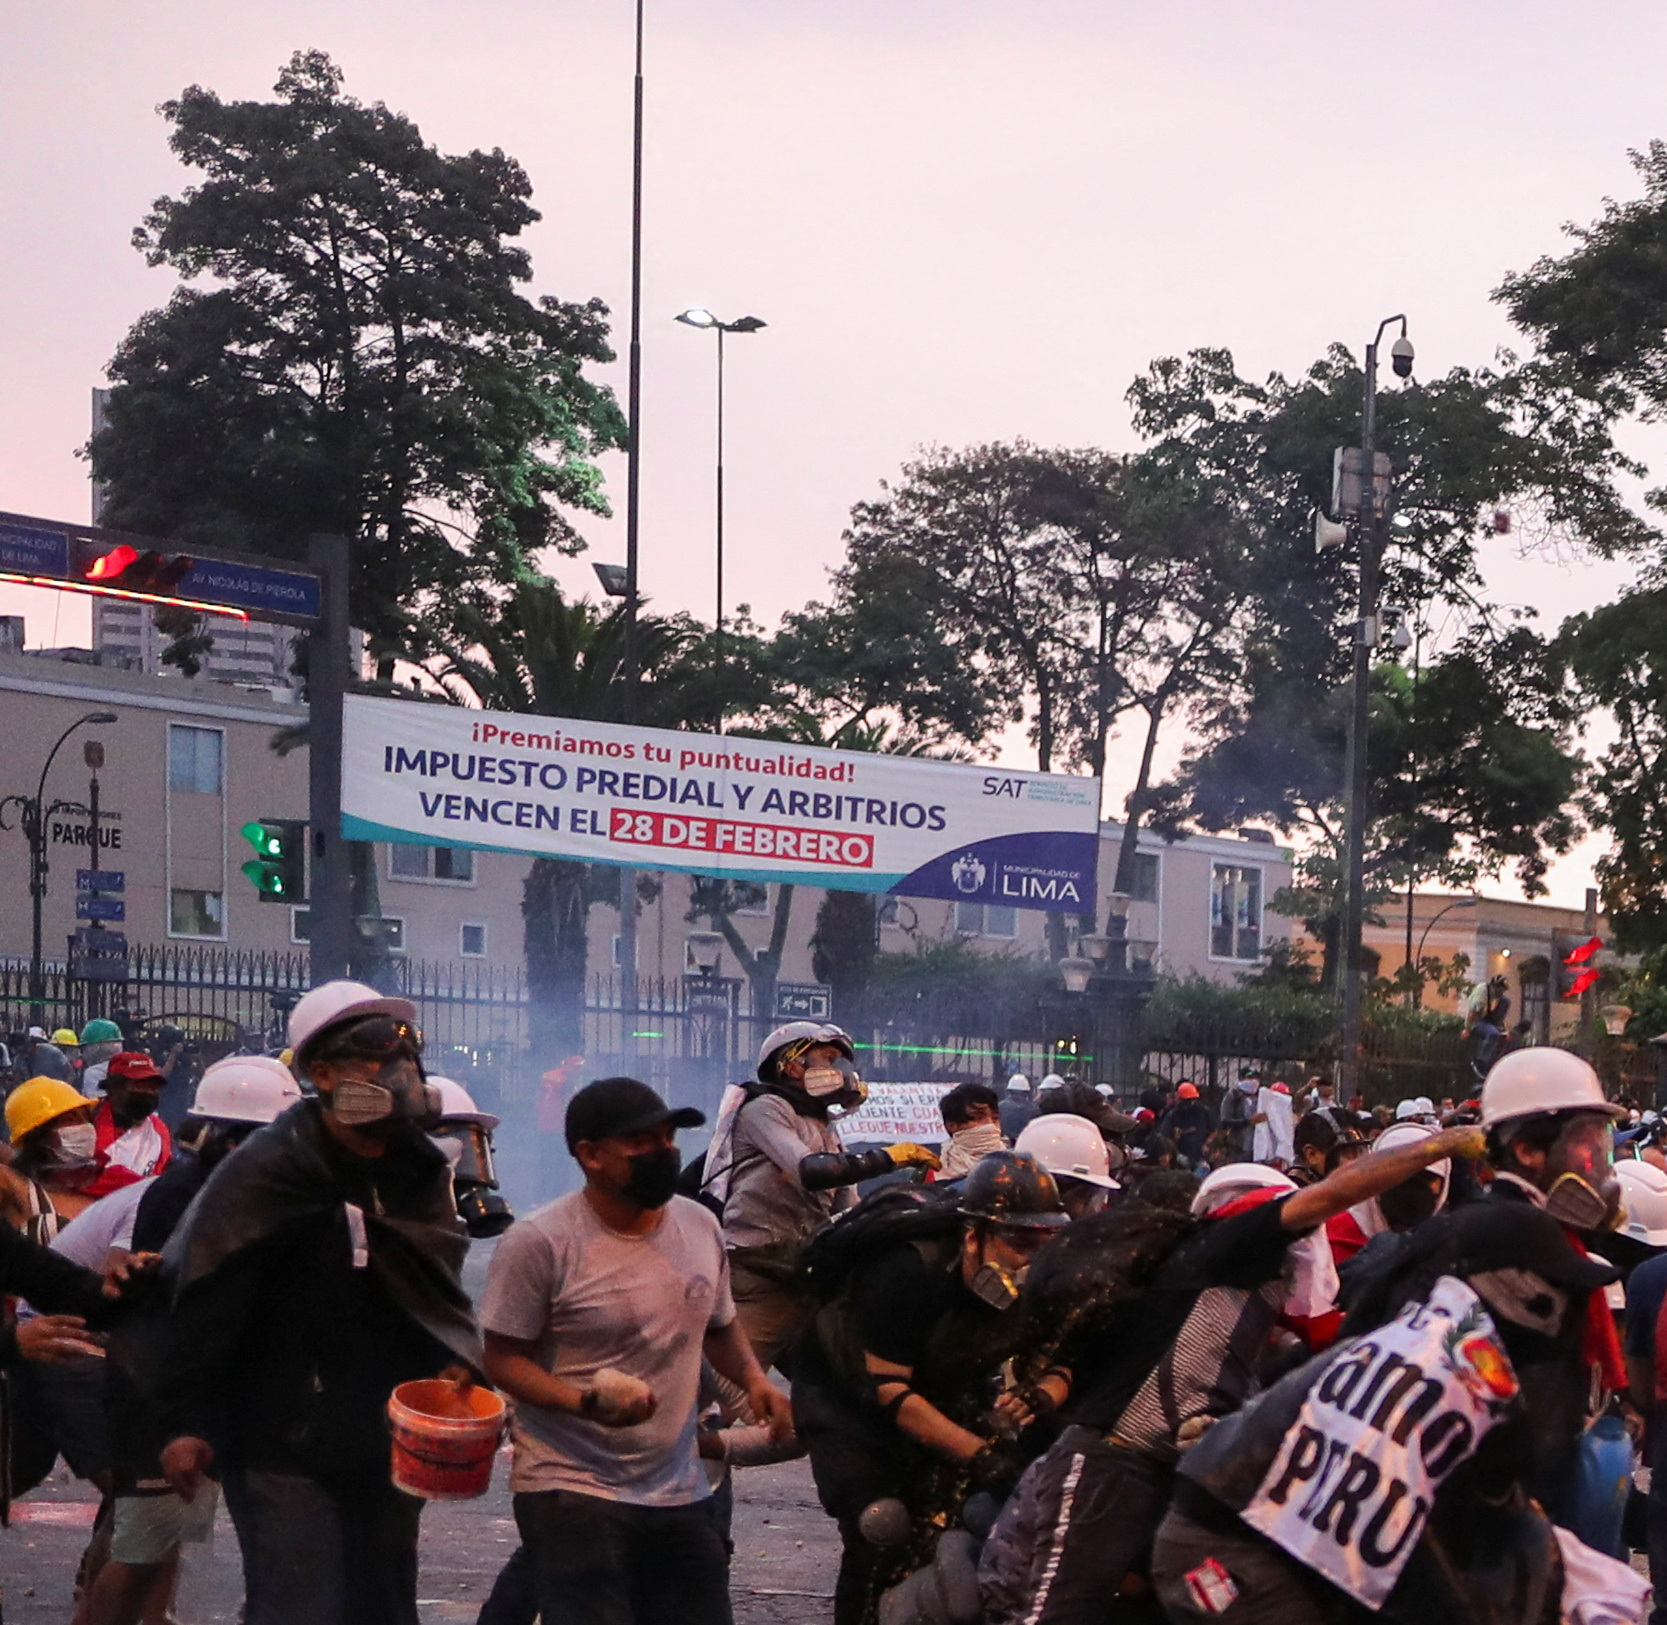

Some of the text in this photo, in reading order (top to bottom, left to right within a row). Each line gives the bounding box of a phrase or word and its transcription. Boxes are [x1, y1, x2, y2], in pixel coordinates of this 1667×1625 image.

[642, 742, 672, 764] tu
[679, 748, 856, 783] puntualidad!
[384, 745, 946, 831] IMPUESTO PREDIAL Y ARBITRIOS
[982, 776, 1028, 799] SAT
[418, 791, 870, 865] VENCEN EL 28 DE FEBRERO
[1003, 864, 1080, 880] MUNICIPALIDAD DE
[1003, 874, 1080, 903] LIMA
[1317, 1341, 1474, 1479] amo
